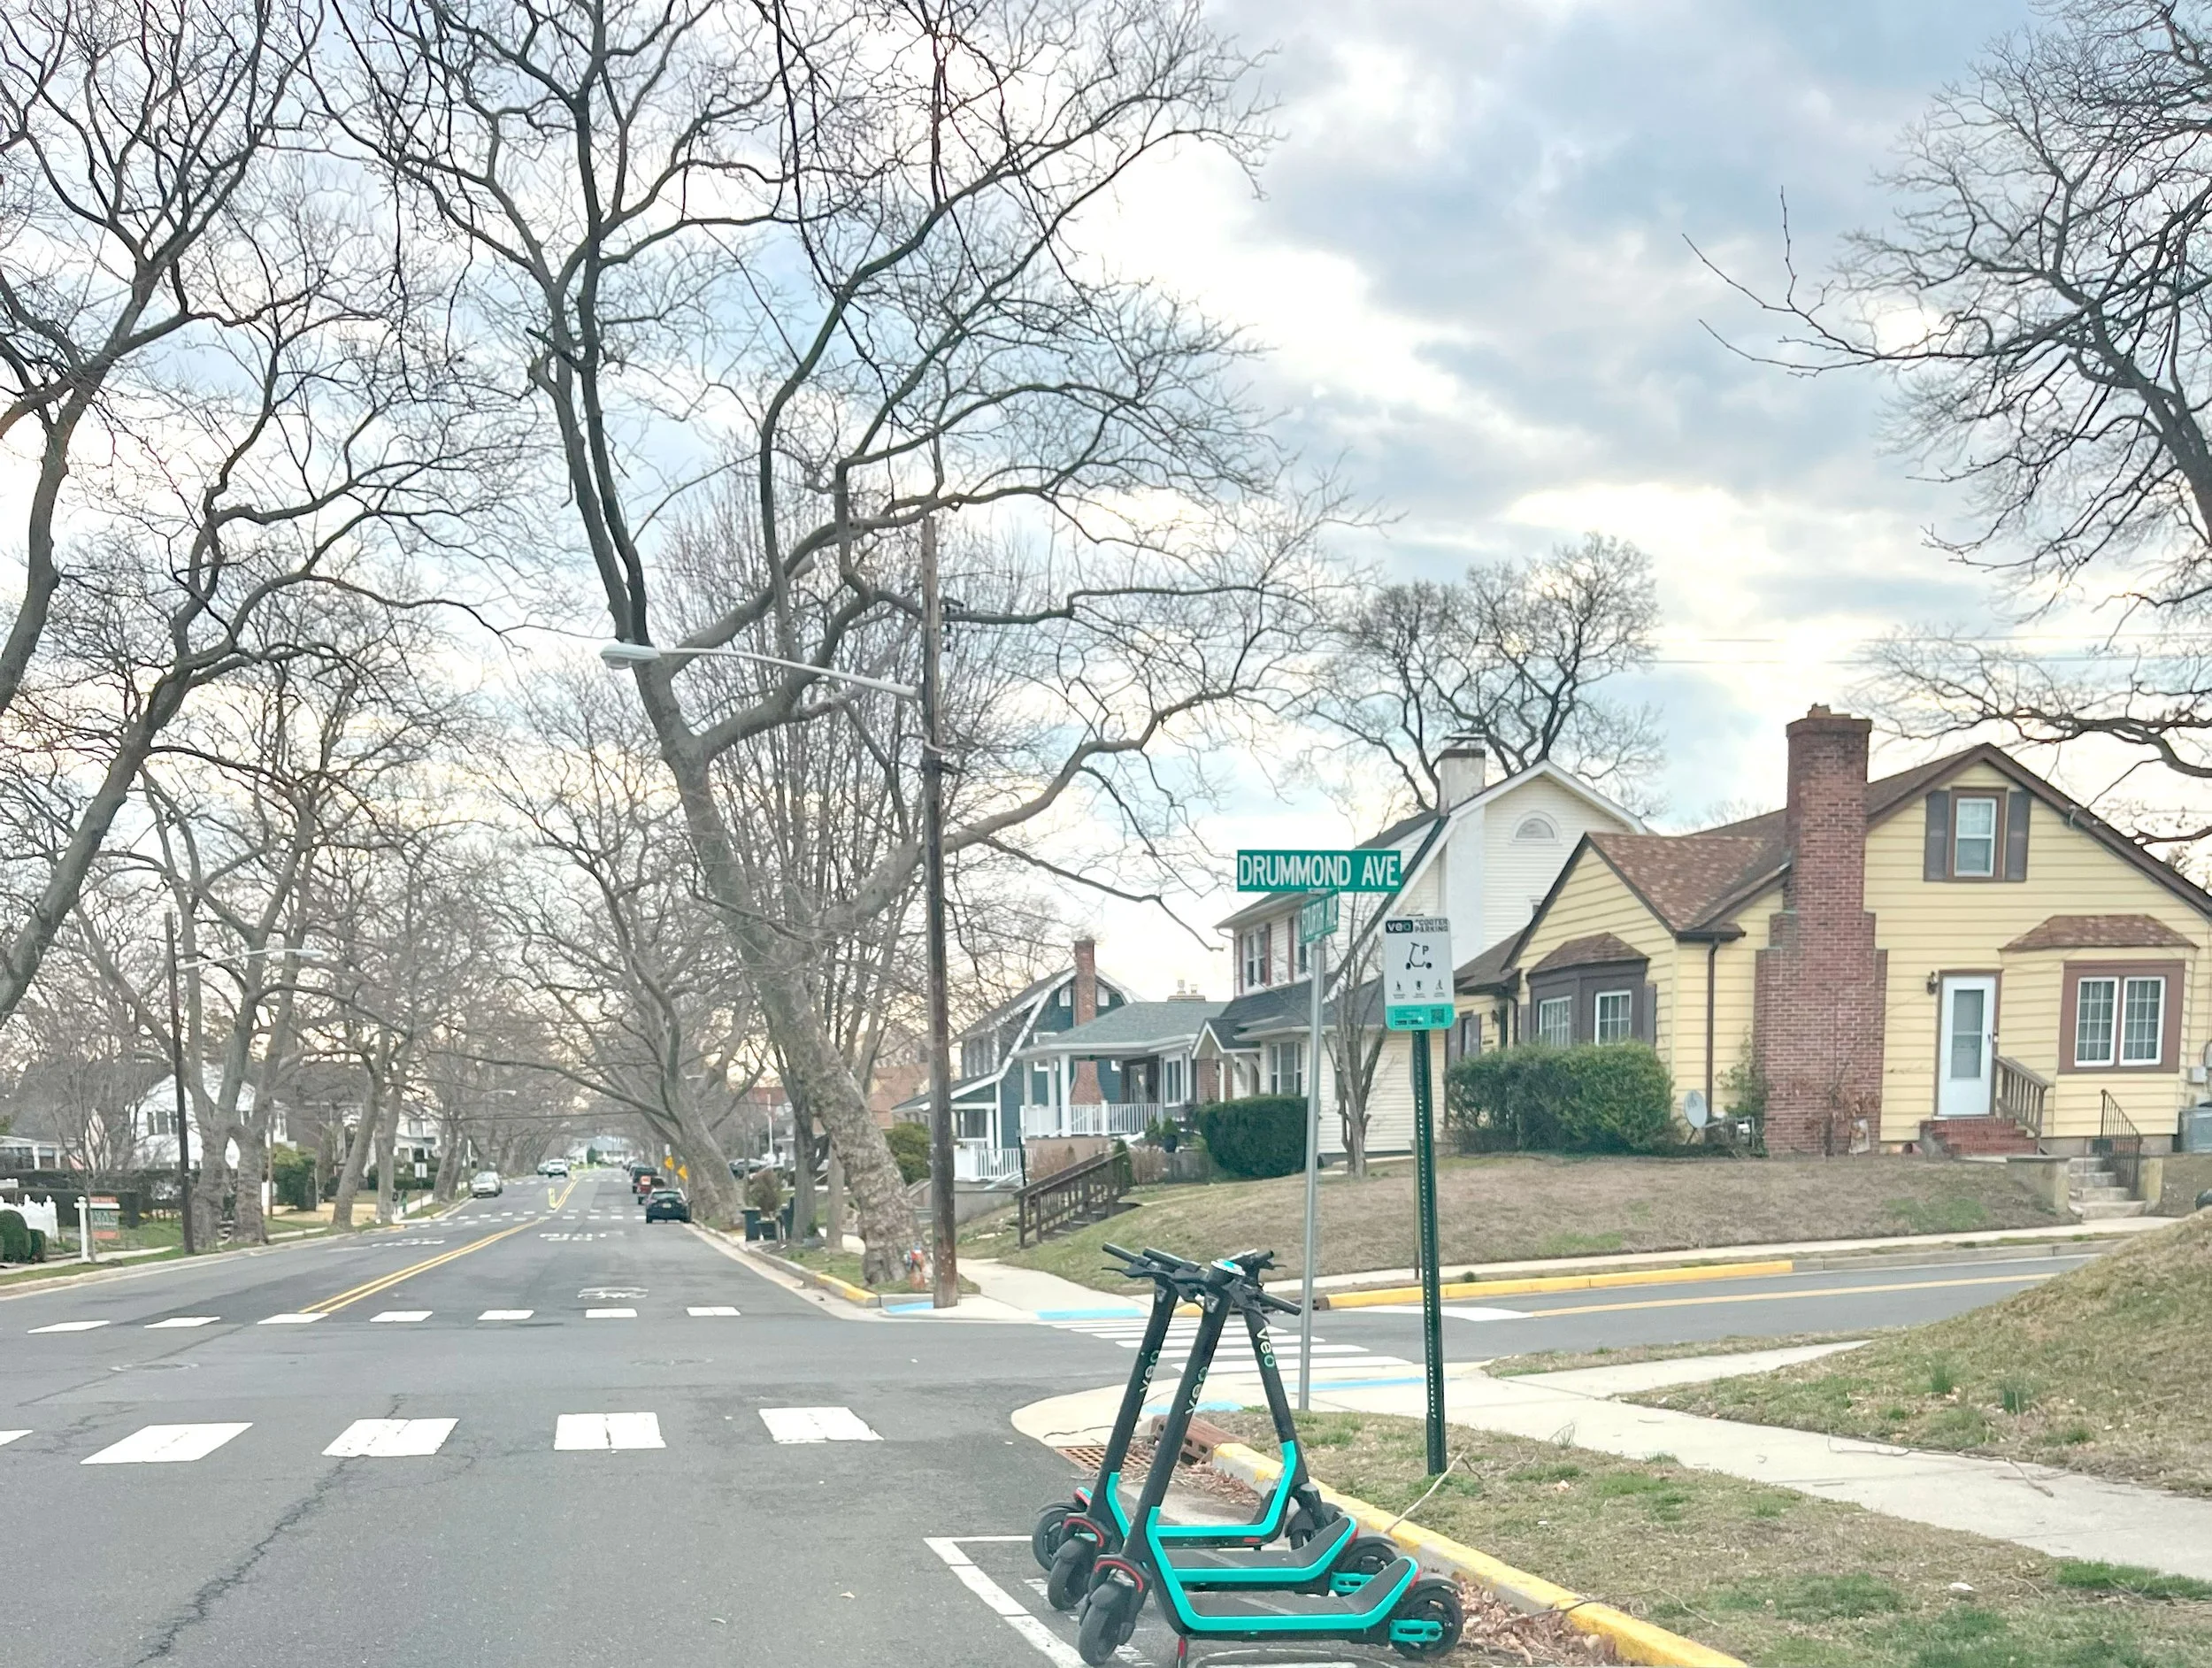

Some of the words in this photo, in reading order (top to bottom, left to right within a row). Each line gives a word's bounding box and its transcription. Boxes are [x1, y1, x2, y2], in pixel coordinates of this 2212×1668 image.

[1240, 855, 1351, 886] DRUMMOND
[1362, 856, 1399, 886] AVE
[1387, 923, 1411, 932] veo
[1423, 945, 1429, 955] P
[1256, 1328, 1275, 1367] veo
